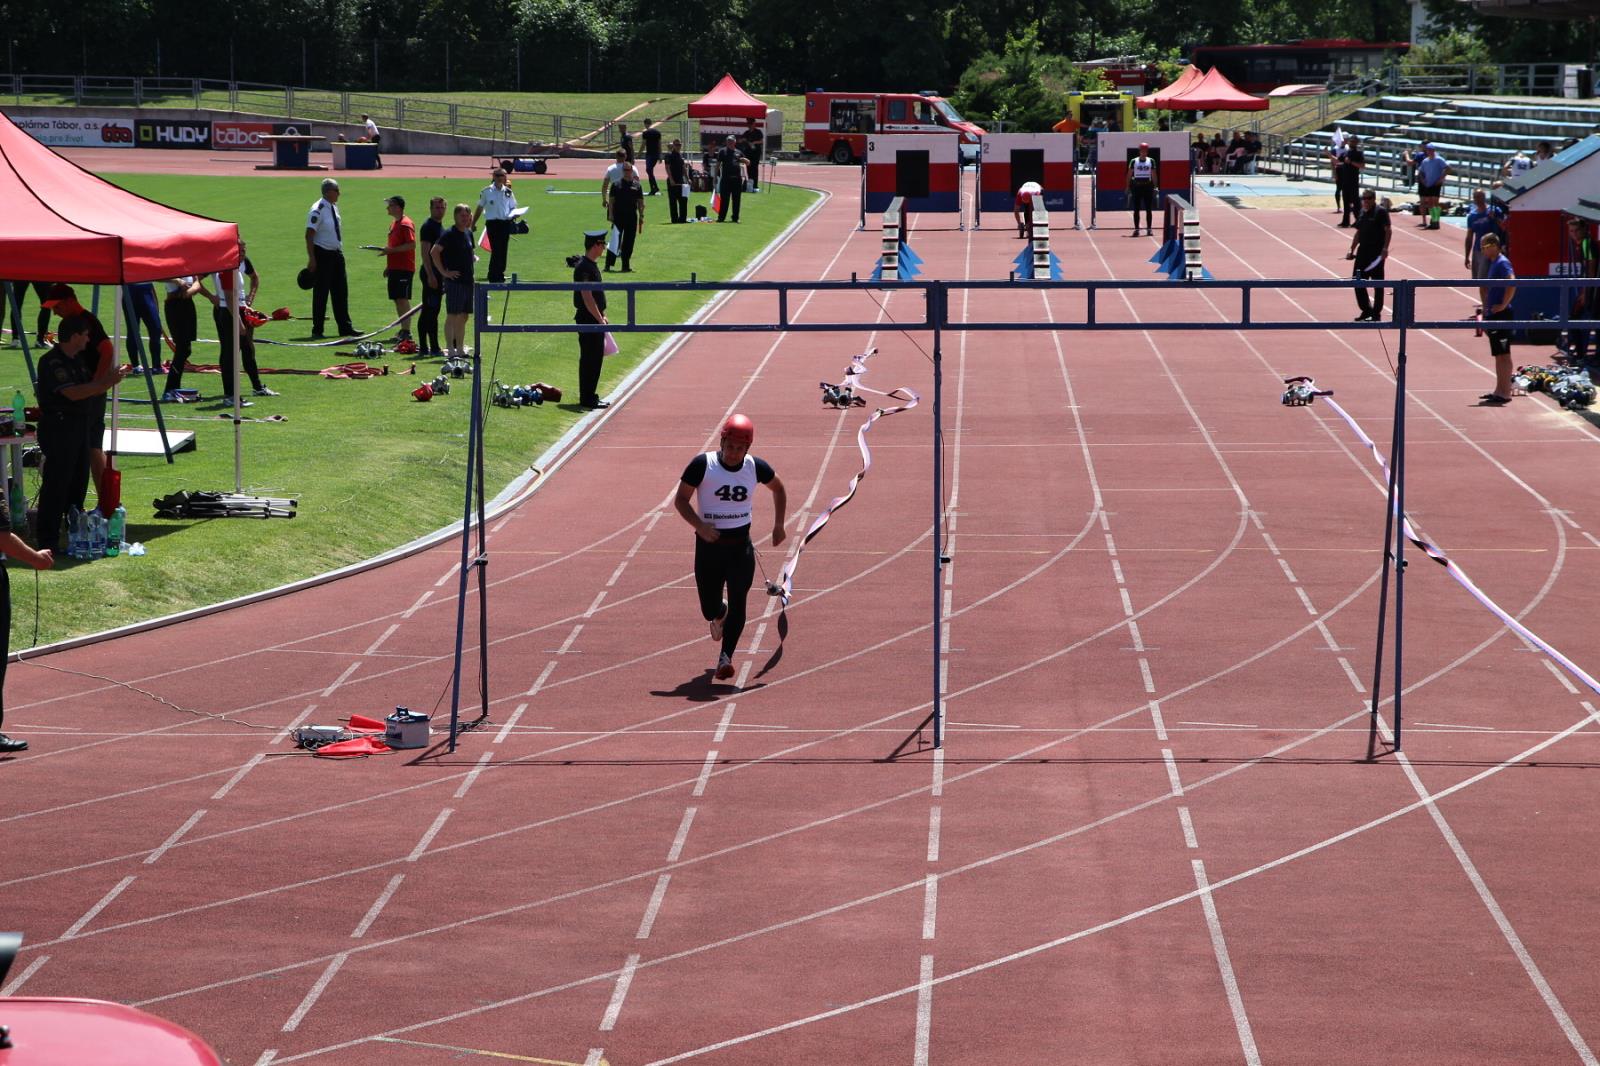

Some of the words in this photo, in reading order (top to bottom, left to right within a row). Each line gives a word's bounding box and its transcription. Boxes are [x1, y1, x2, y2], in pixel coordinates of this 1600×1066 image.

[156, 126, 208, 143] HUDY
[868, 142, 875, 151] 3
[983, 143, 990, 154] 2
[714, 485, 748, 502] 48
